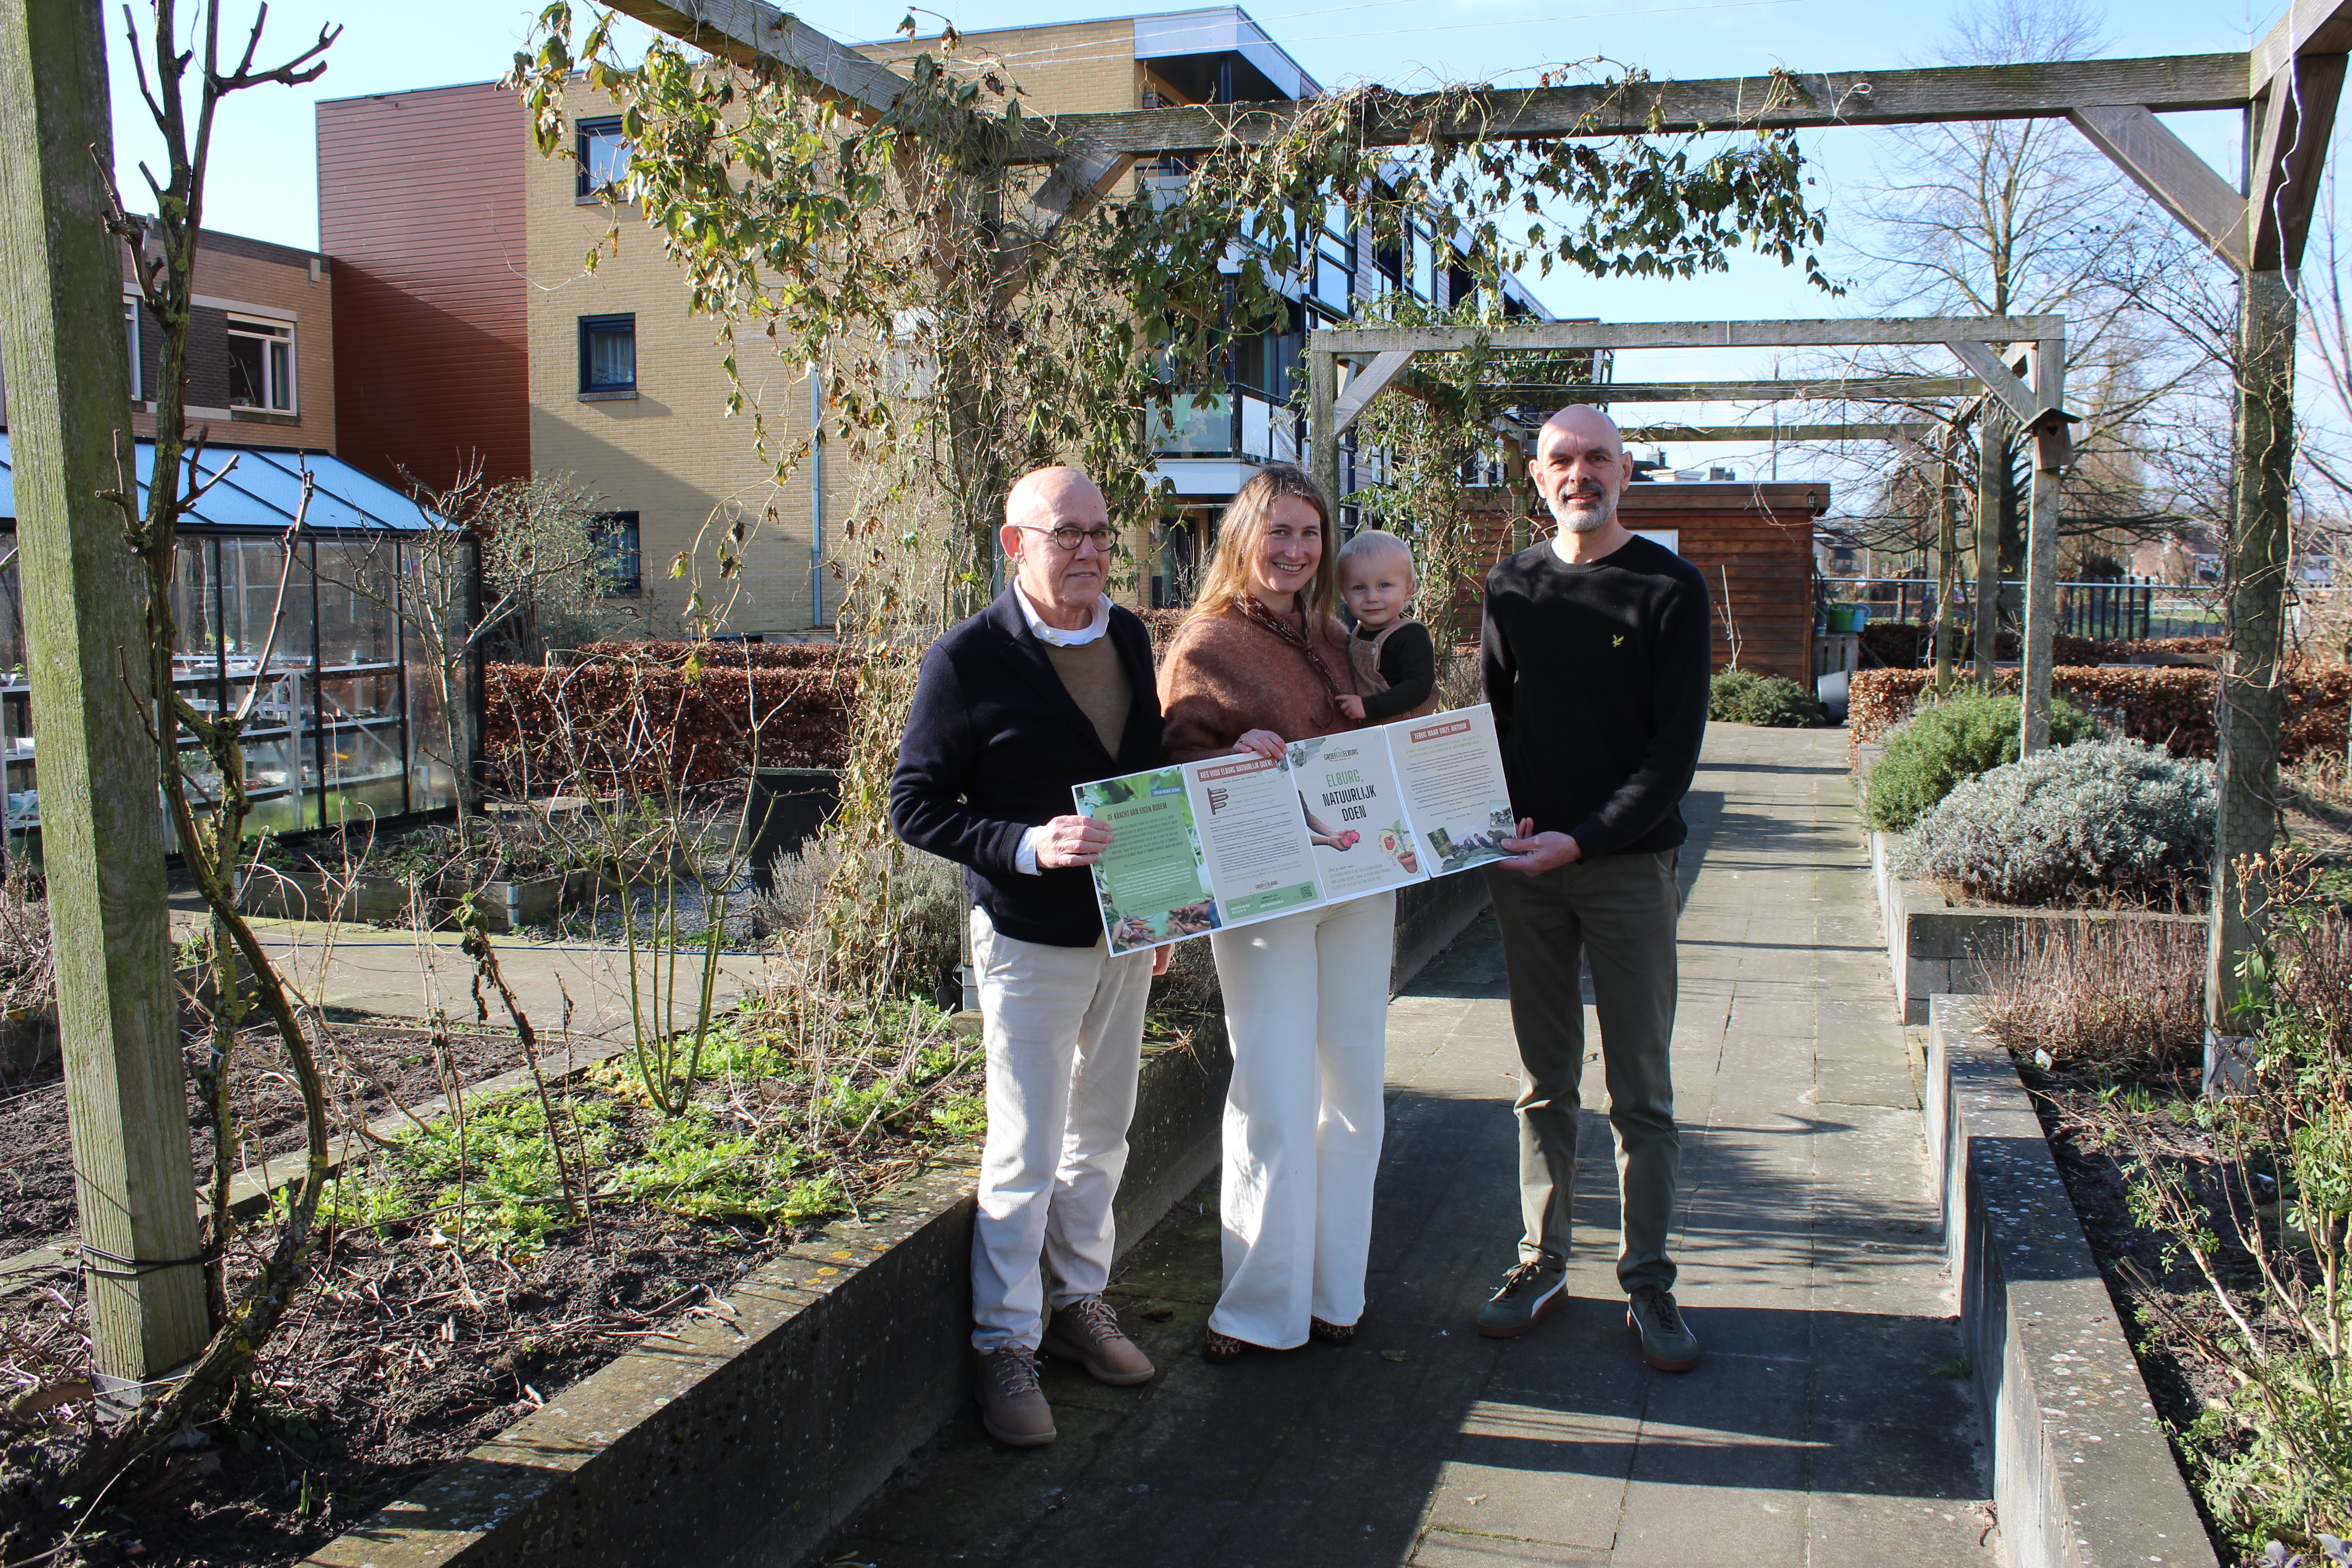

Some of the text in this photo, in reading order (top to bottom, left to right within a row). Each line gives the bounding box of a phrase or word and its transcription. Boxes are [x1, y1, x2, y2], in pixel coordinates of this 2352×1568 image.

[1414, 731, 1426, 740] TERUG
[1439, 726, 1450, 734] ONZE
[1451, 723, 1467, 731] NATUUR
[1210, 769, 1220, 777] VOOR
[1221, 766, 1235, 775] ELBURG
[1236, 762, 1259, 773] NATUURLIJK
[1260, 760, 1273, 768] DOEN!
[1326, 769, 1364, 787] ELBURG,
[1322, 785, 1377, 807] NATUURLIJK
[1114, 810, 1129, 819] KRACHT
[1140, 806, 1152, 814] EIGEN
[1153, 802, 1167, 811] BODEM
[1342, 805, 1367, 821] DOEN
